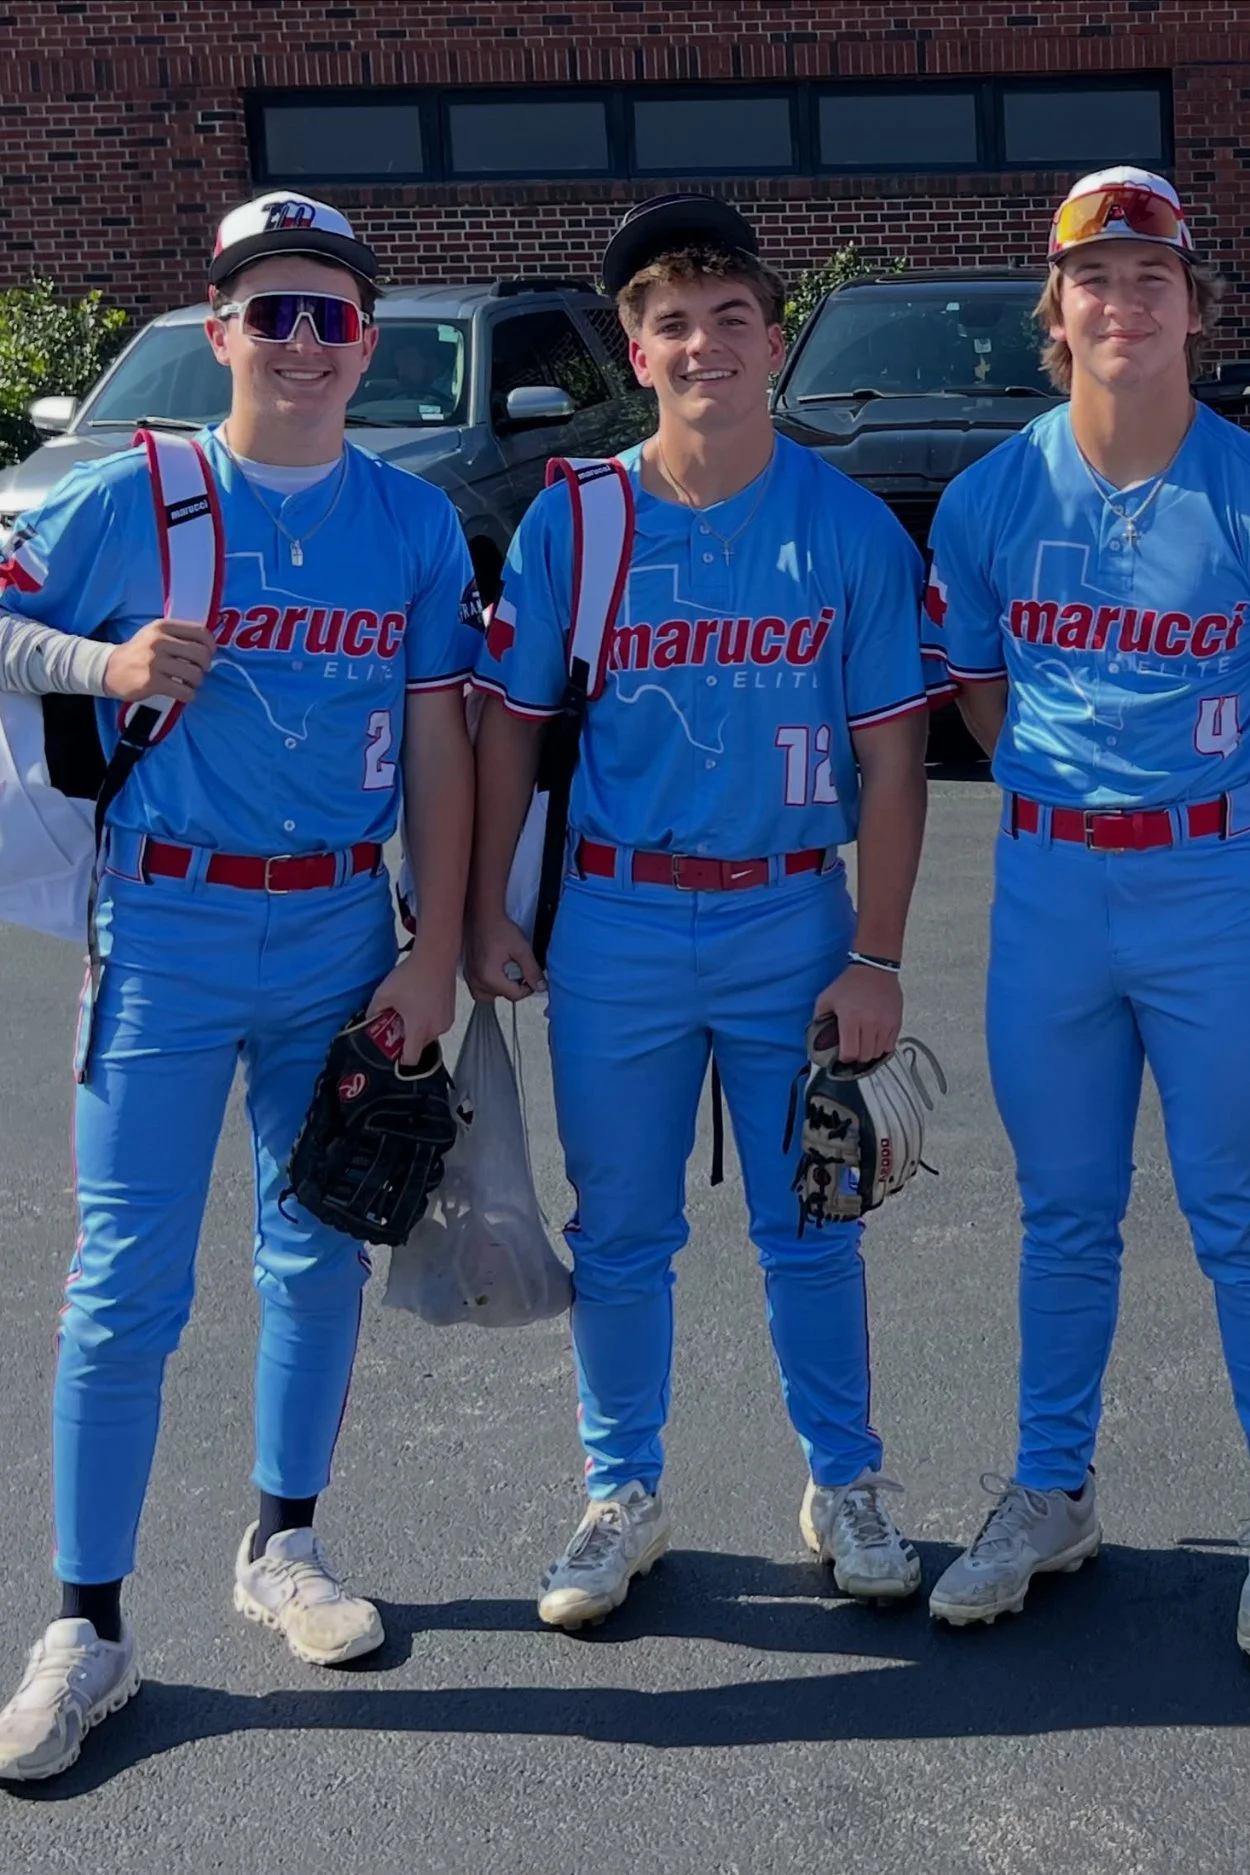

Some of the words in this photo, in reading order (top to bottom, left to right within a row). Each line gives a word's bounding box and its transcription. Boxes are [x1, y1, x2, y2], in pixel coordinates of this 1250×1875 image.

[607, 606, 836, 672] marucci
[1008, 600, 1250, 659] marucci
[361, 709, 397, 791] 2
[1193, 694, 1242, 760] 4
[774, 724, 839, 807] 12
